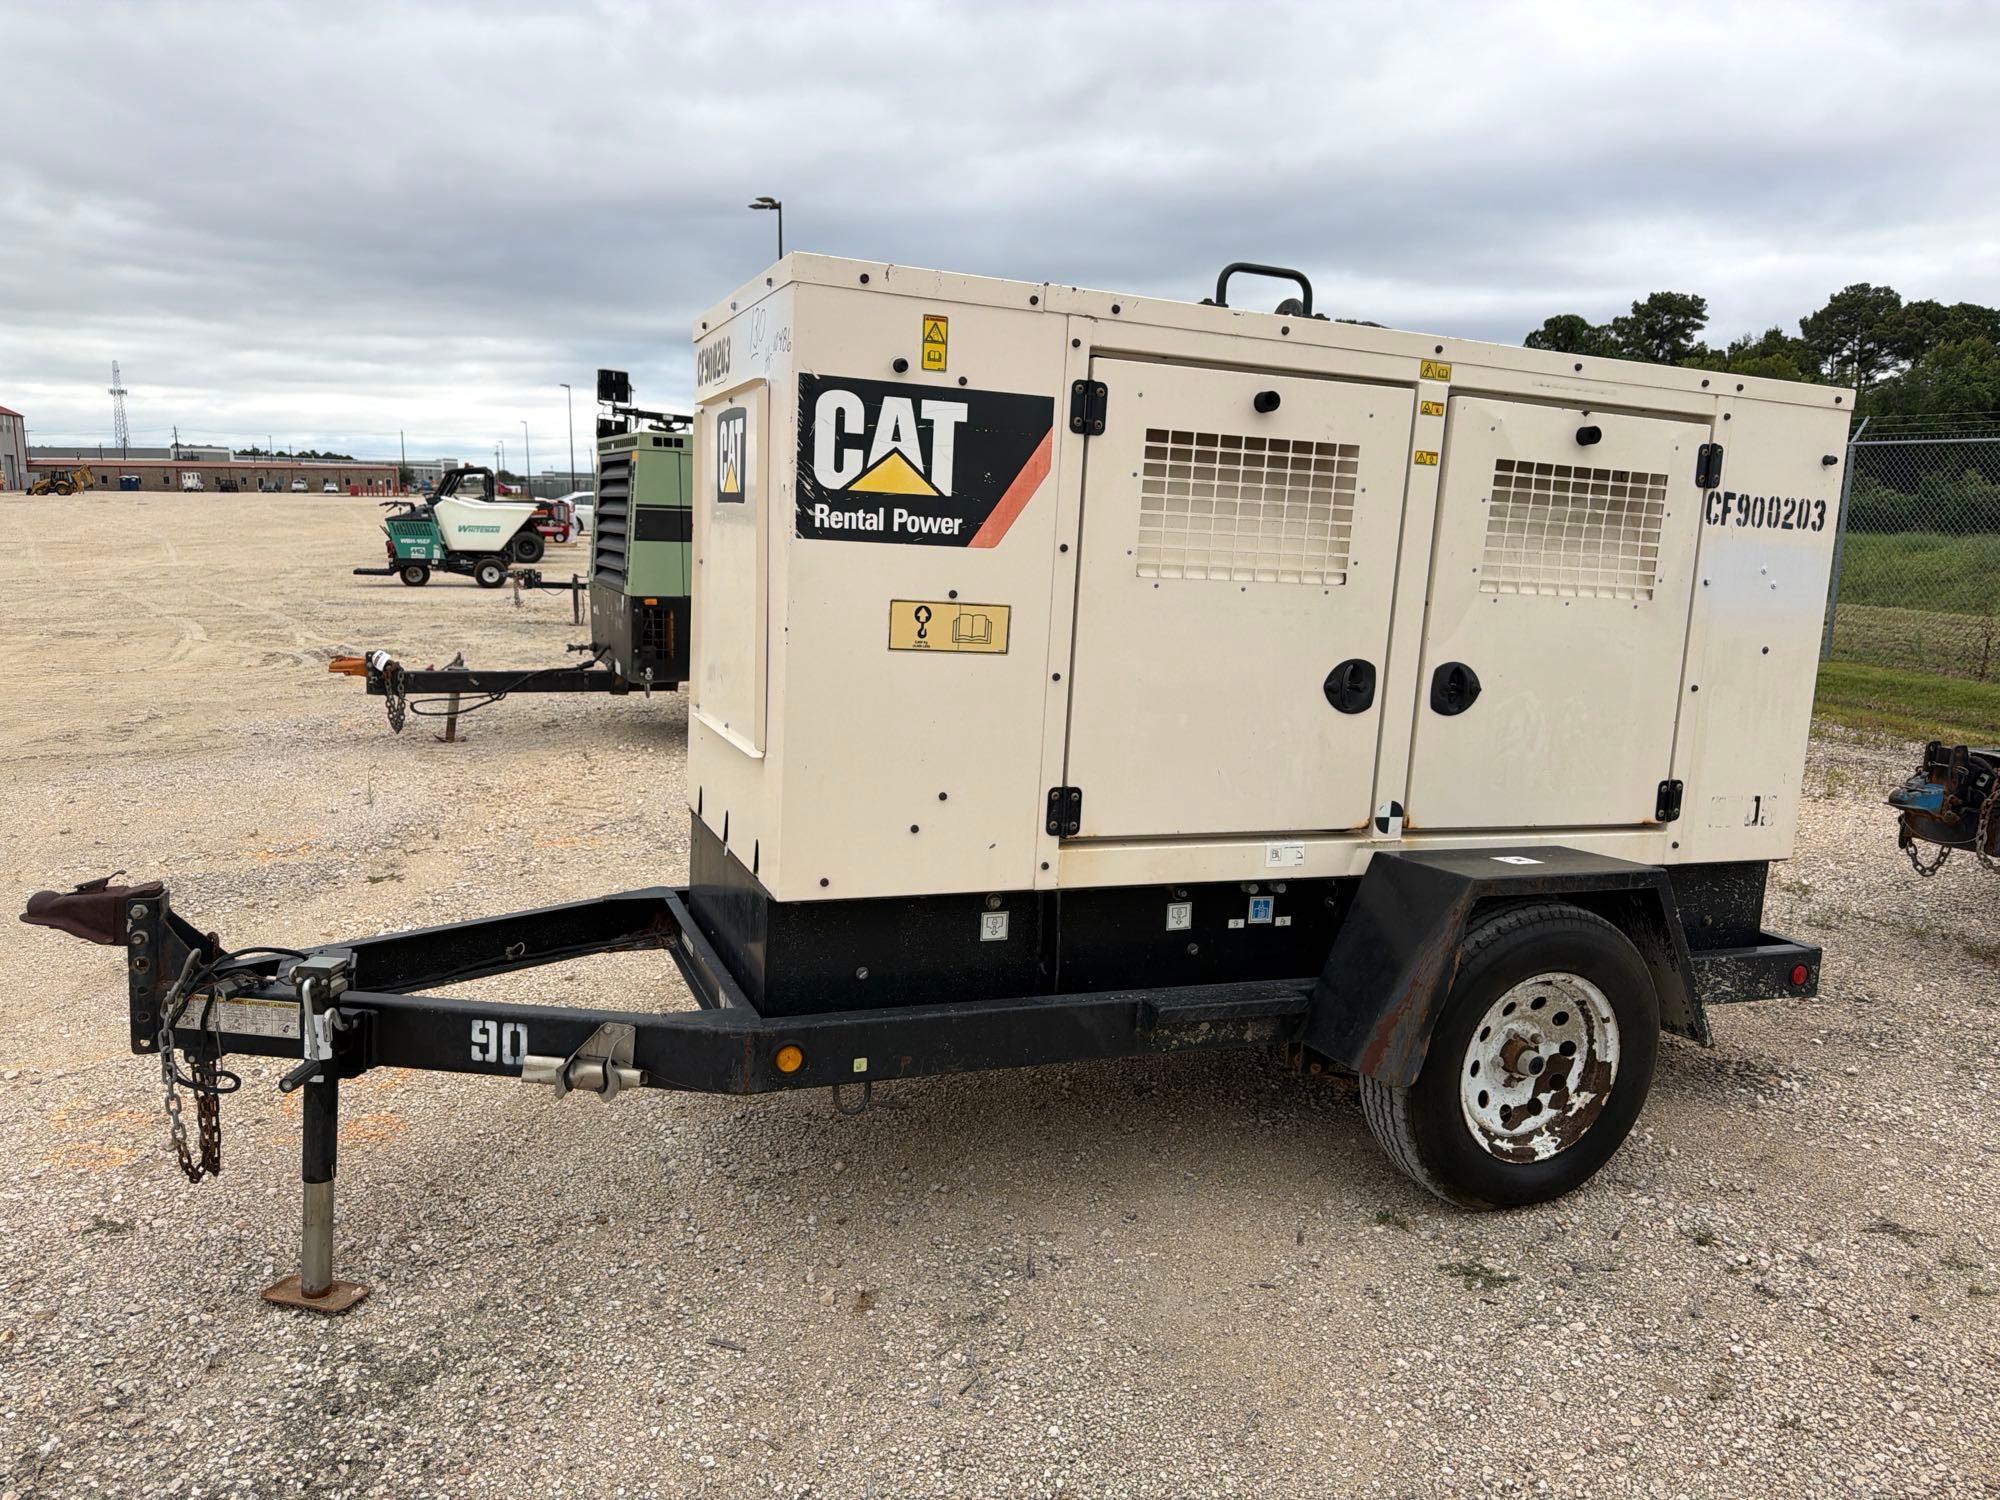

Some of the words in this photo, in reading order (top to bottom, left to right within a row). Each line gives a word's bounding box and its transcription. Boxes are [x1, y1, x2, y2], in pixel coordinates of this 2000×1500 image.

[697, 335, 731, 388] CF900203
[720, 417, 744, 493] CAT
[813, 389, 969, 497] CAT
[814, 503, 885, 531] Rental
[893, 507, 963, 535] Power
[1706, 490, 1827, 532] CF900203
[471, 1019, 528, 1065] 90
